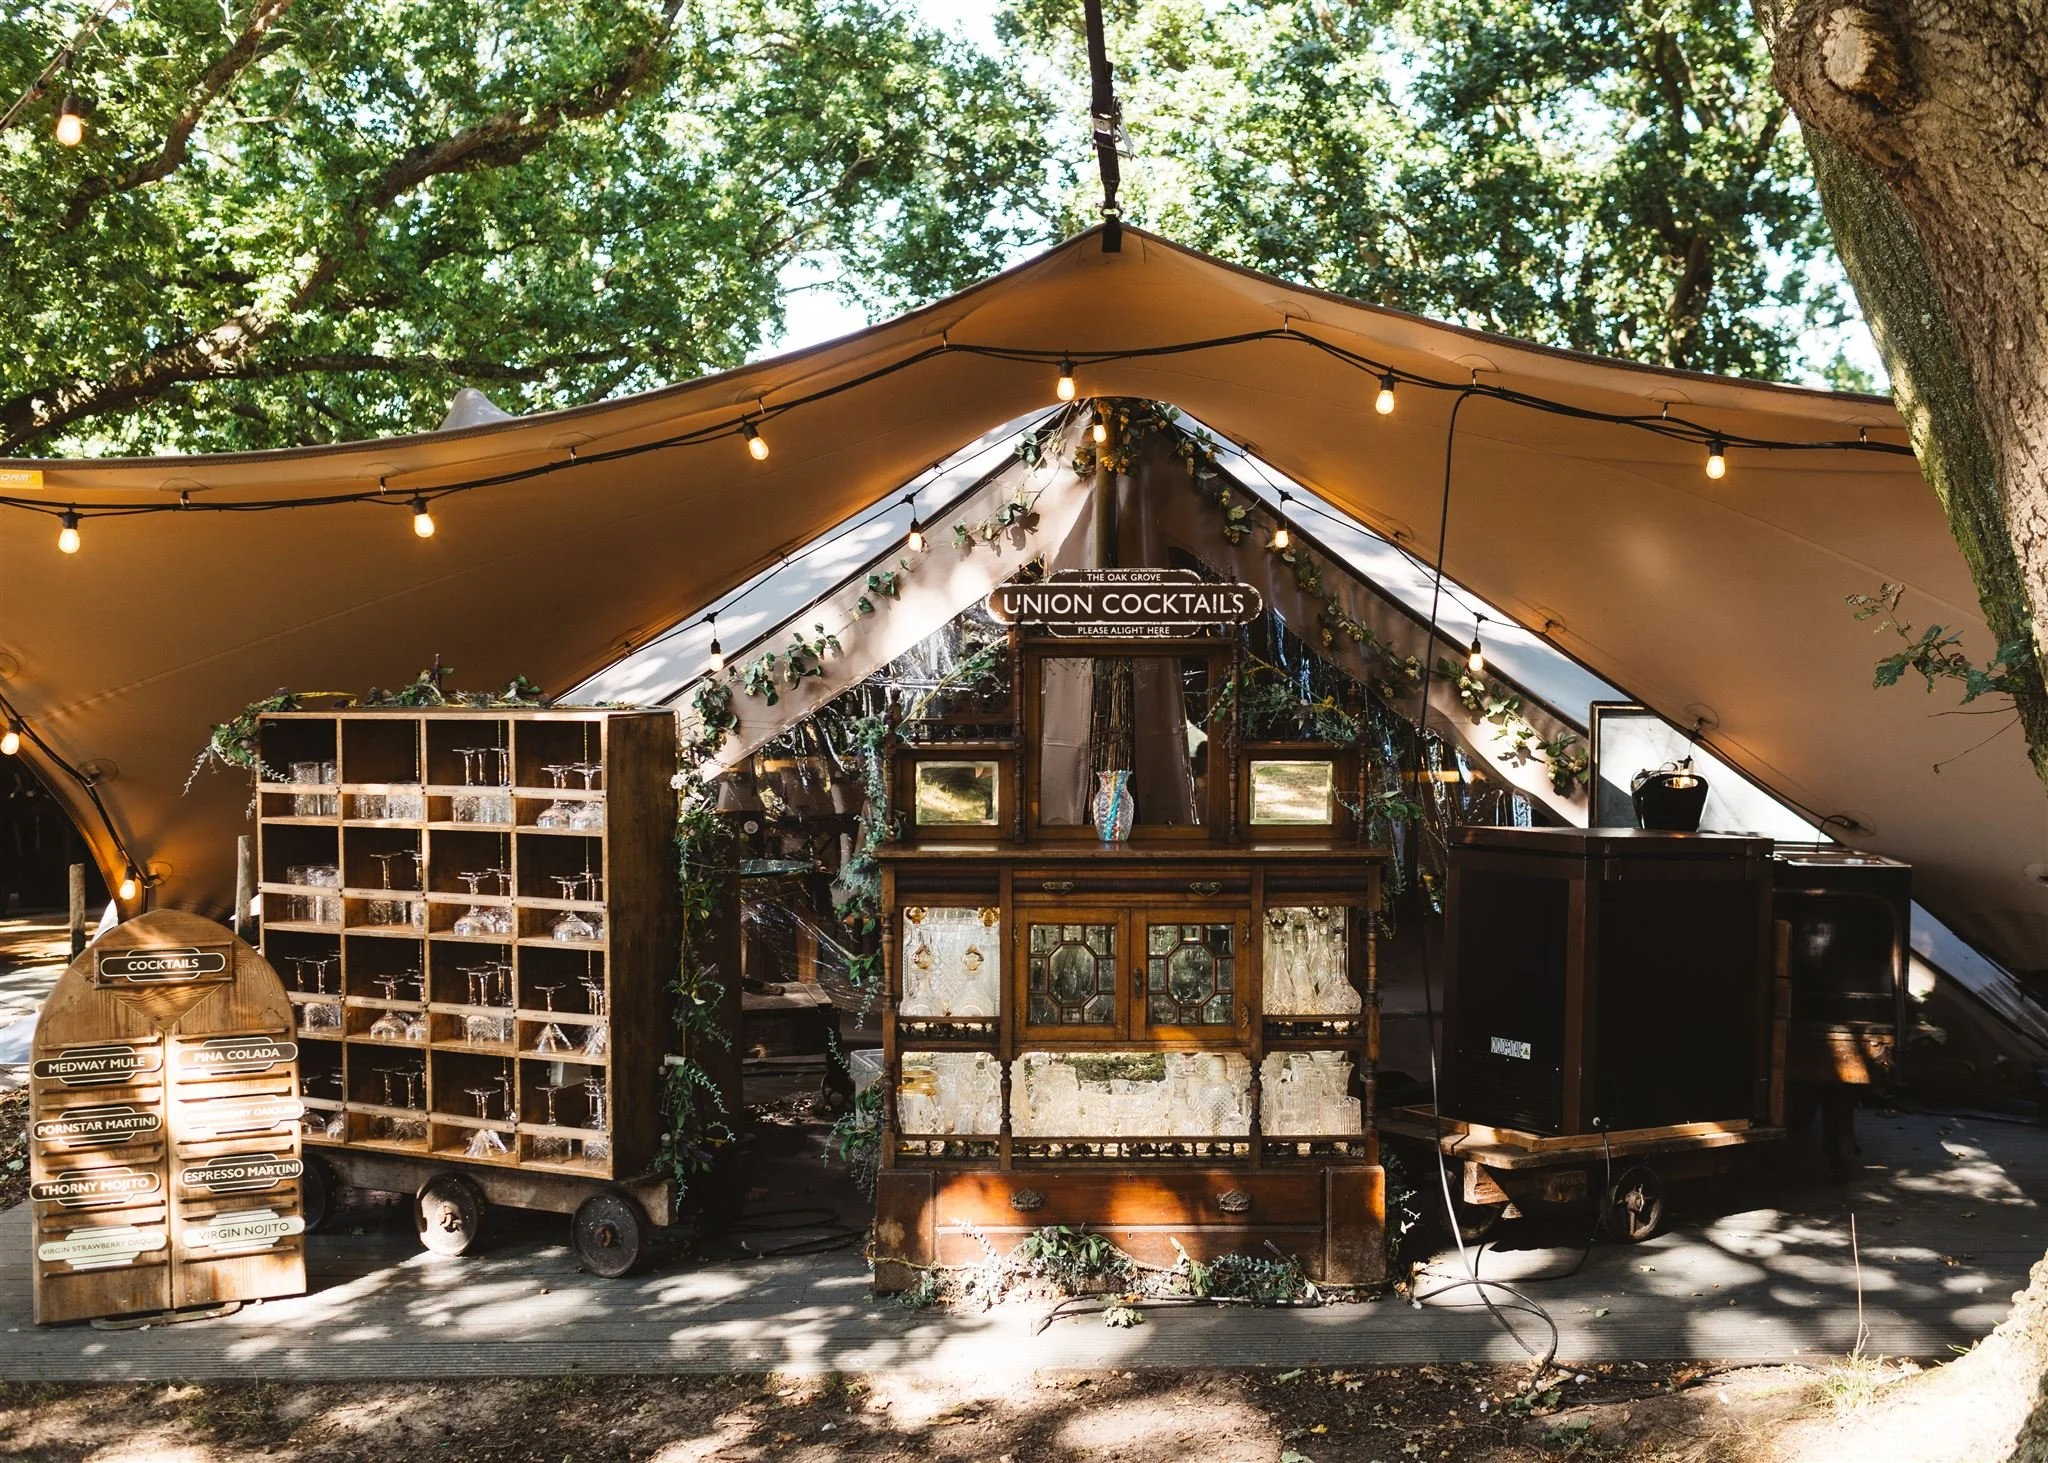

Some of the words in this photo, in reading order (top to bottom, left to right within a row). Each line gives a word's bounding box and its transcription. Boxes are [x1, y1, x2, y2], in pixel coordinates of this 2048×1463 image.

[1087, 573, 1105, 582] THE
[1107, 573, 1128, 582] OAK
[1130, 573, 1161, 582] GROVE
[1003, 593, 1092, 615] UNION
[1102, 593, 1245, 615] COCKTAILS
[1078, 626, 1109, 635] PLEASE
[1110, 626, 1145, 635] ALIGHT
[1147, 626, 1170, 635] HERE
[127, 958, 199, 971] COCKTAILS
[193, 1050, 223, 1063] PINA
[226, 1047, 281, 1060] COLADA
[48, 1060, 107, 1074] MEDWAY
[110, 1057, 146, 1069] MULE
[37, 1121, 103, 1136] PORNSTAR
[105, 1117, 156, 1131] MARTINI
[184, 1168, 244, 1183] ESPRESSO
[247, 1163, 299, 1177] MARTINI
[39, 1182, 98, 1196] THORNY
[100, 1177, 150, 1192] MOJITO
[199, 1227, 241, 1241] VIRGIN
[244, 1222, 290, 1236] NOJITO
[42, 1246, 70, 1256] VIRGIN
[72, 1240, 125, 1253] STRAWBERRY
